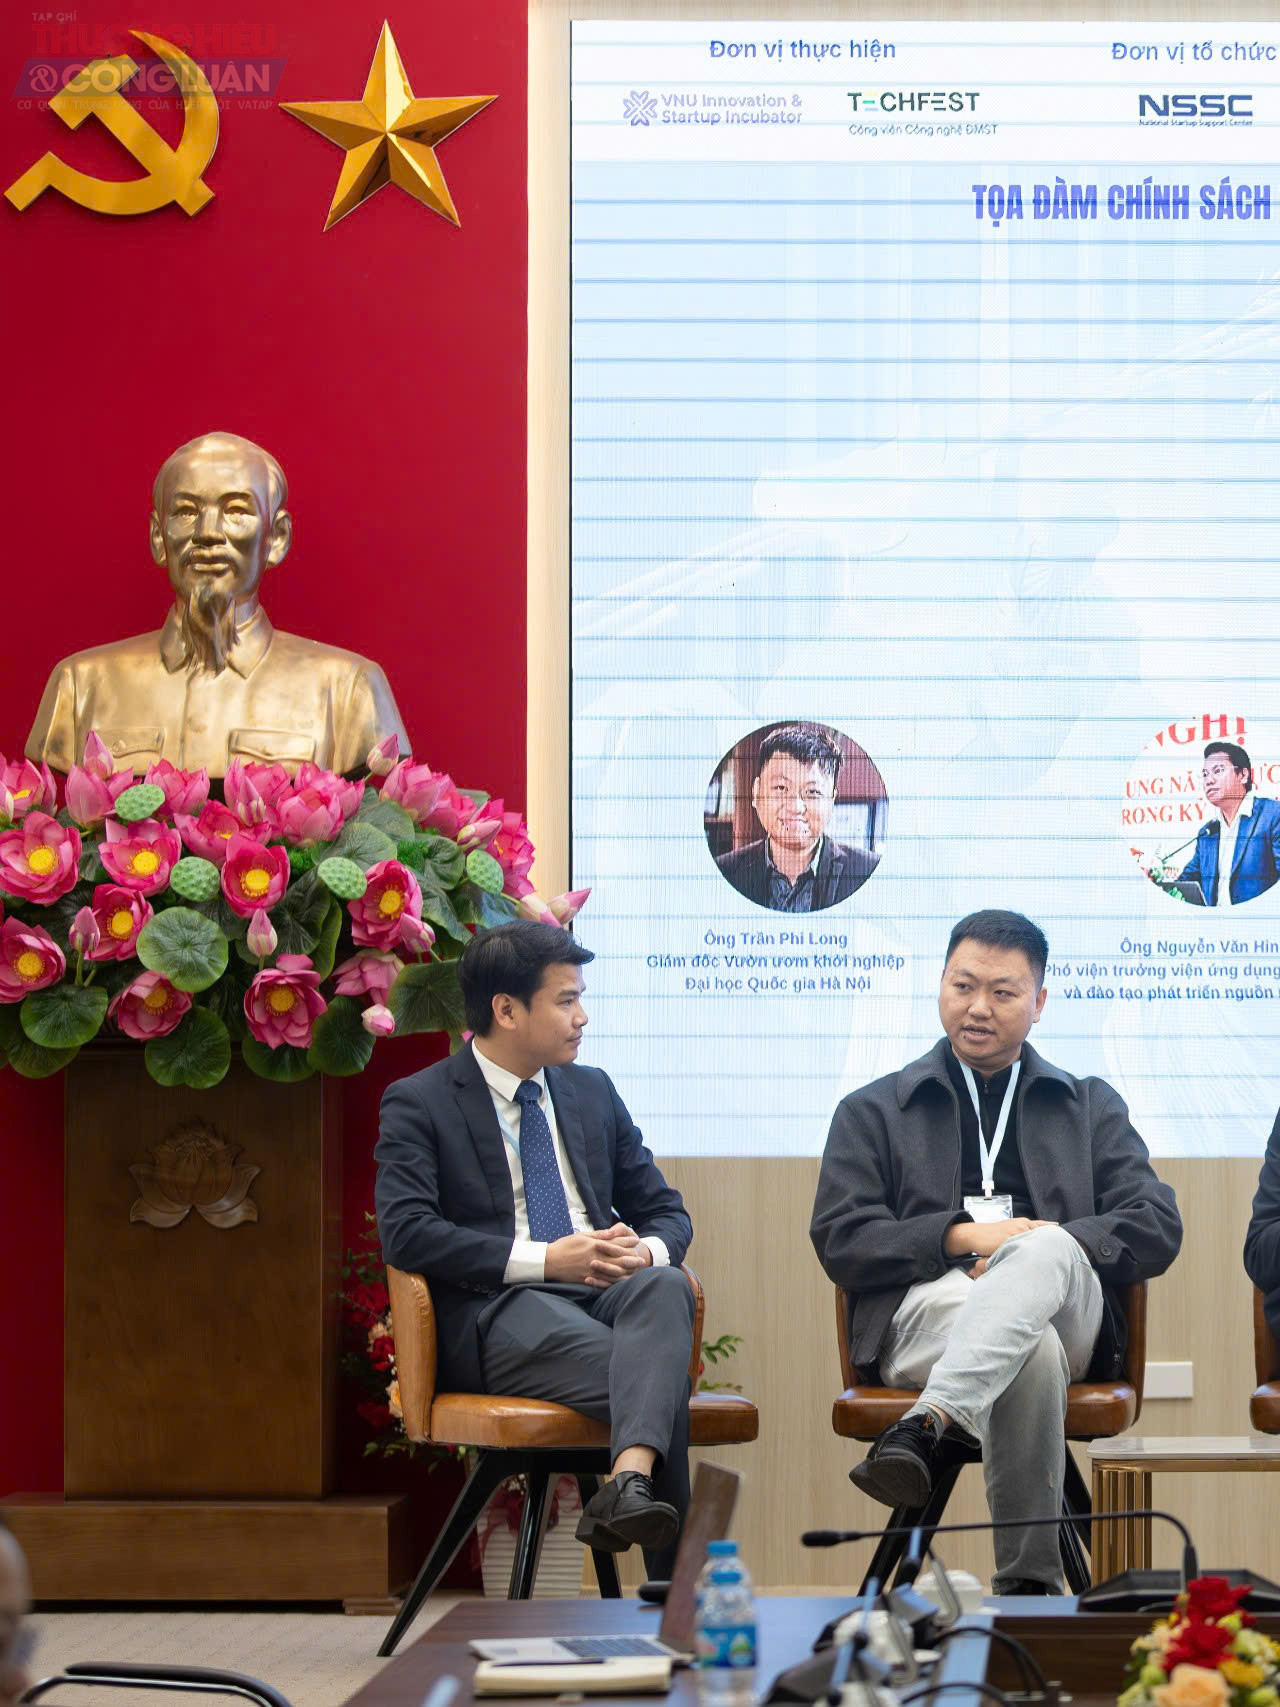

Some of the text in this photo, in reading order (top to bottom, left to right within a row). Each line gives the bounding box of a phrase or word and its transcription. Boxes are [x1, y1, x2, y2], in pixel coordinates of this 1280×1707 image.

[710, 39, 896, 63] Đơn vị thực hiện
[1112, 42, 1158, 61] Đơn
[1166, 41, 1185, 64] vị
[1221, 41, 1277, 61] chức
[661, 93, 802, 107] VNU Innovation &
[847, 91, 980, 112] TECHFEST
[1138, 94, 1253, 116] NSSC
[662, 109, 802, 125] Startup Incubator
[971, 184, 1023, 228] TỌA
[1032, 175, 1097, 220] ĐÀM
[1107, 175, 1190, 220] CHÍNH
[1200, 175, 1271, 220] SÁCH
[704, 929, 735, 949] Ông
[779, 931, 804, 945] Phi
[809, 931, 848, 949] Long
[1120, 937, 1152, 956] Ông
[1157, 937, 1215, 956] Nguyễn
[1220, 939, 1249, 953] Văn
[647, 953, 905, 971] Giám đốc Vườn ươm khởi nghiệp
[1076, 963, 1108, 979] viện
[1113, 963, 1167, 980] trưởng
[1171, 963, 1203, 979] viện
[1208, 963, 1238, 980] ứng
[685, 976, 871, 994] Đại học Quốc gia Hà Nội
[1063, 985, 1082, 999] và
[1086, 985, 1115, 999] đào
[1119, 986, 1143, 1002] tạo
[1148, 986, 1182, 1002] phát
[1225, 985, 1274, 1001] nguồn
